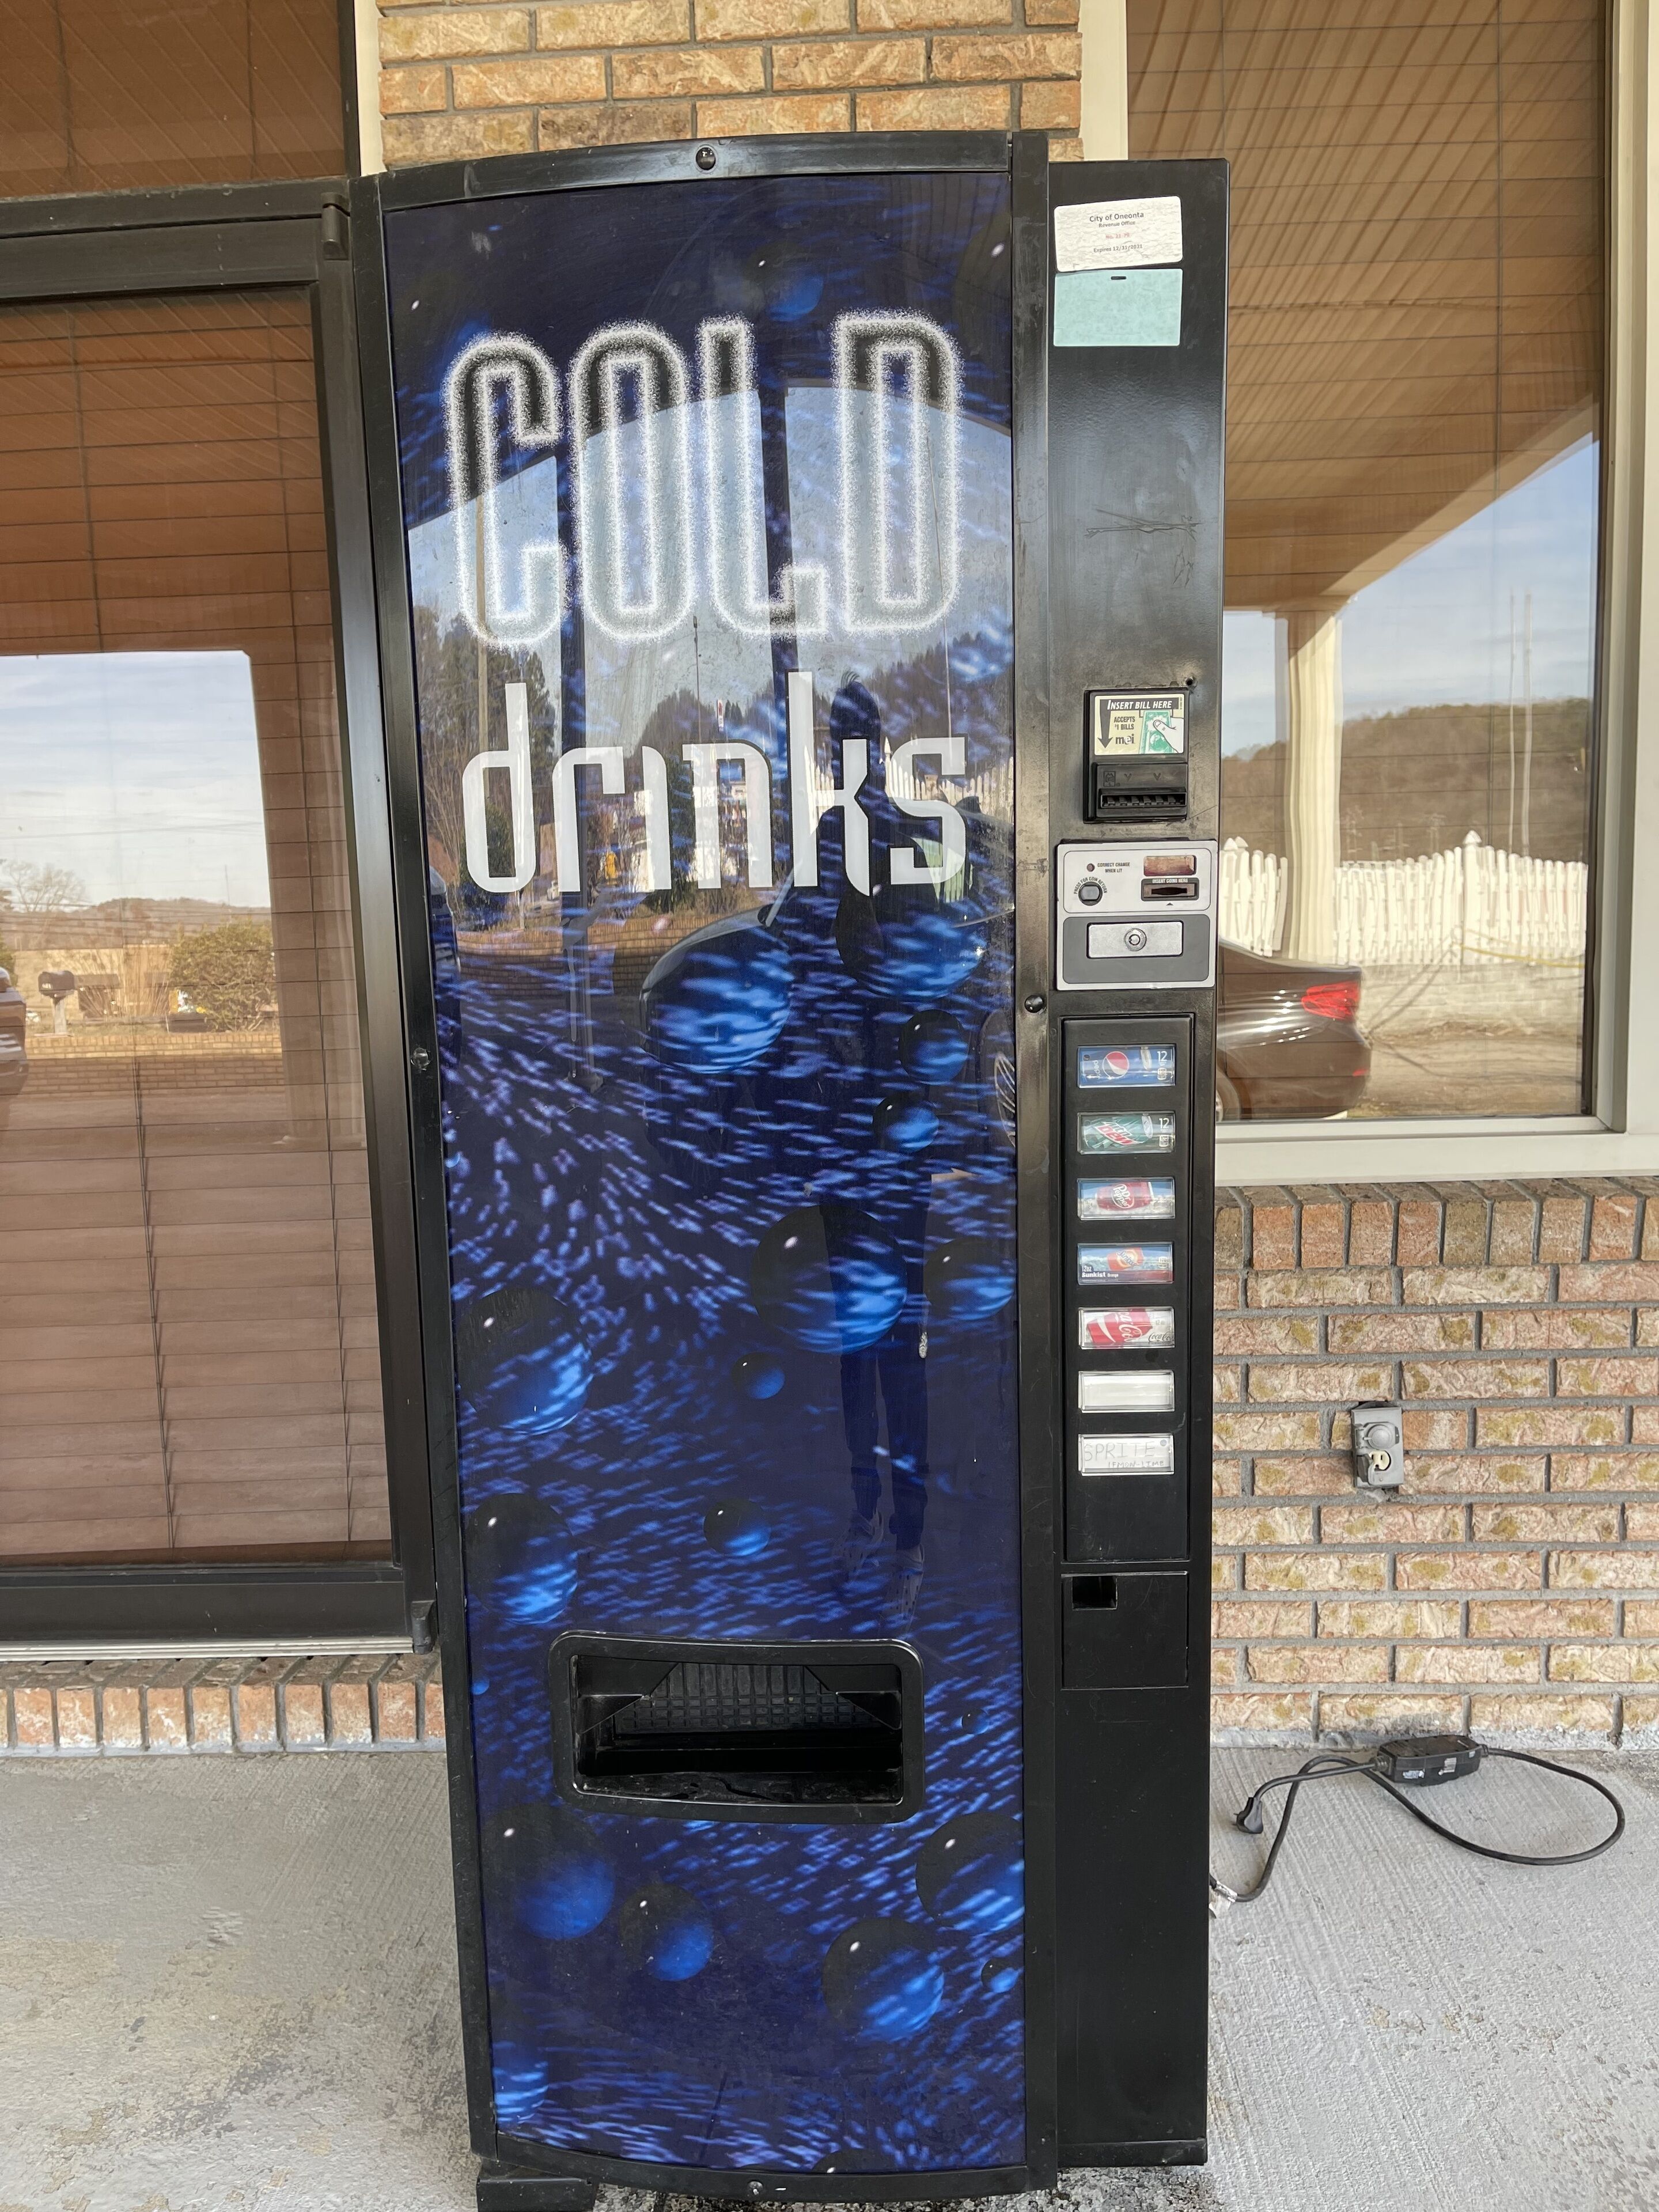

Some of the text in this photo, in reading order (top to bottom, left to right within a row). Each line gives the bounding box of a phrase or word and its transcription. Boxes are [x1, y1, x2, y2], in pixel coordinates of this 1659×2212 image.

[1114, 212, 1144, 220] Oneonta
[1113, 244, 1143, 252] 12/31/2021
[445, 309, 965, 649] COLD
[1107, 700, 1134, 710] INSERT
[1135, 701, 1151, 710] BILL
[1153, 700, 1173, 709] HERE
[1115, 733, 1135, 745] mei
[461, 671, 967, 897] drinks
[1157, 1050, 1168, 1062] 12
[1092, 1060, 1103, 1080] peps
[1158, 1118, 1170, 1130] 12
[1084, 1441, 1156, 1461] SPRITE
